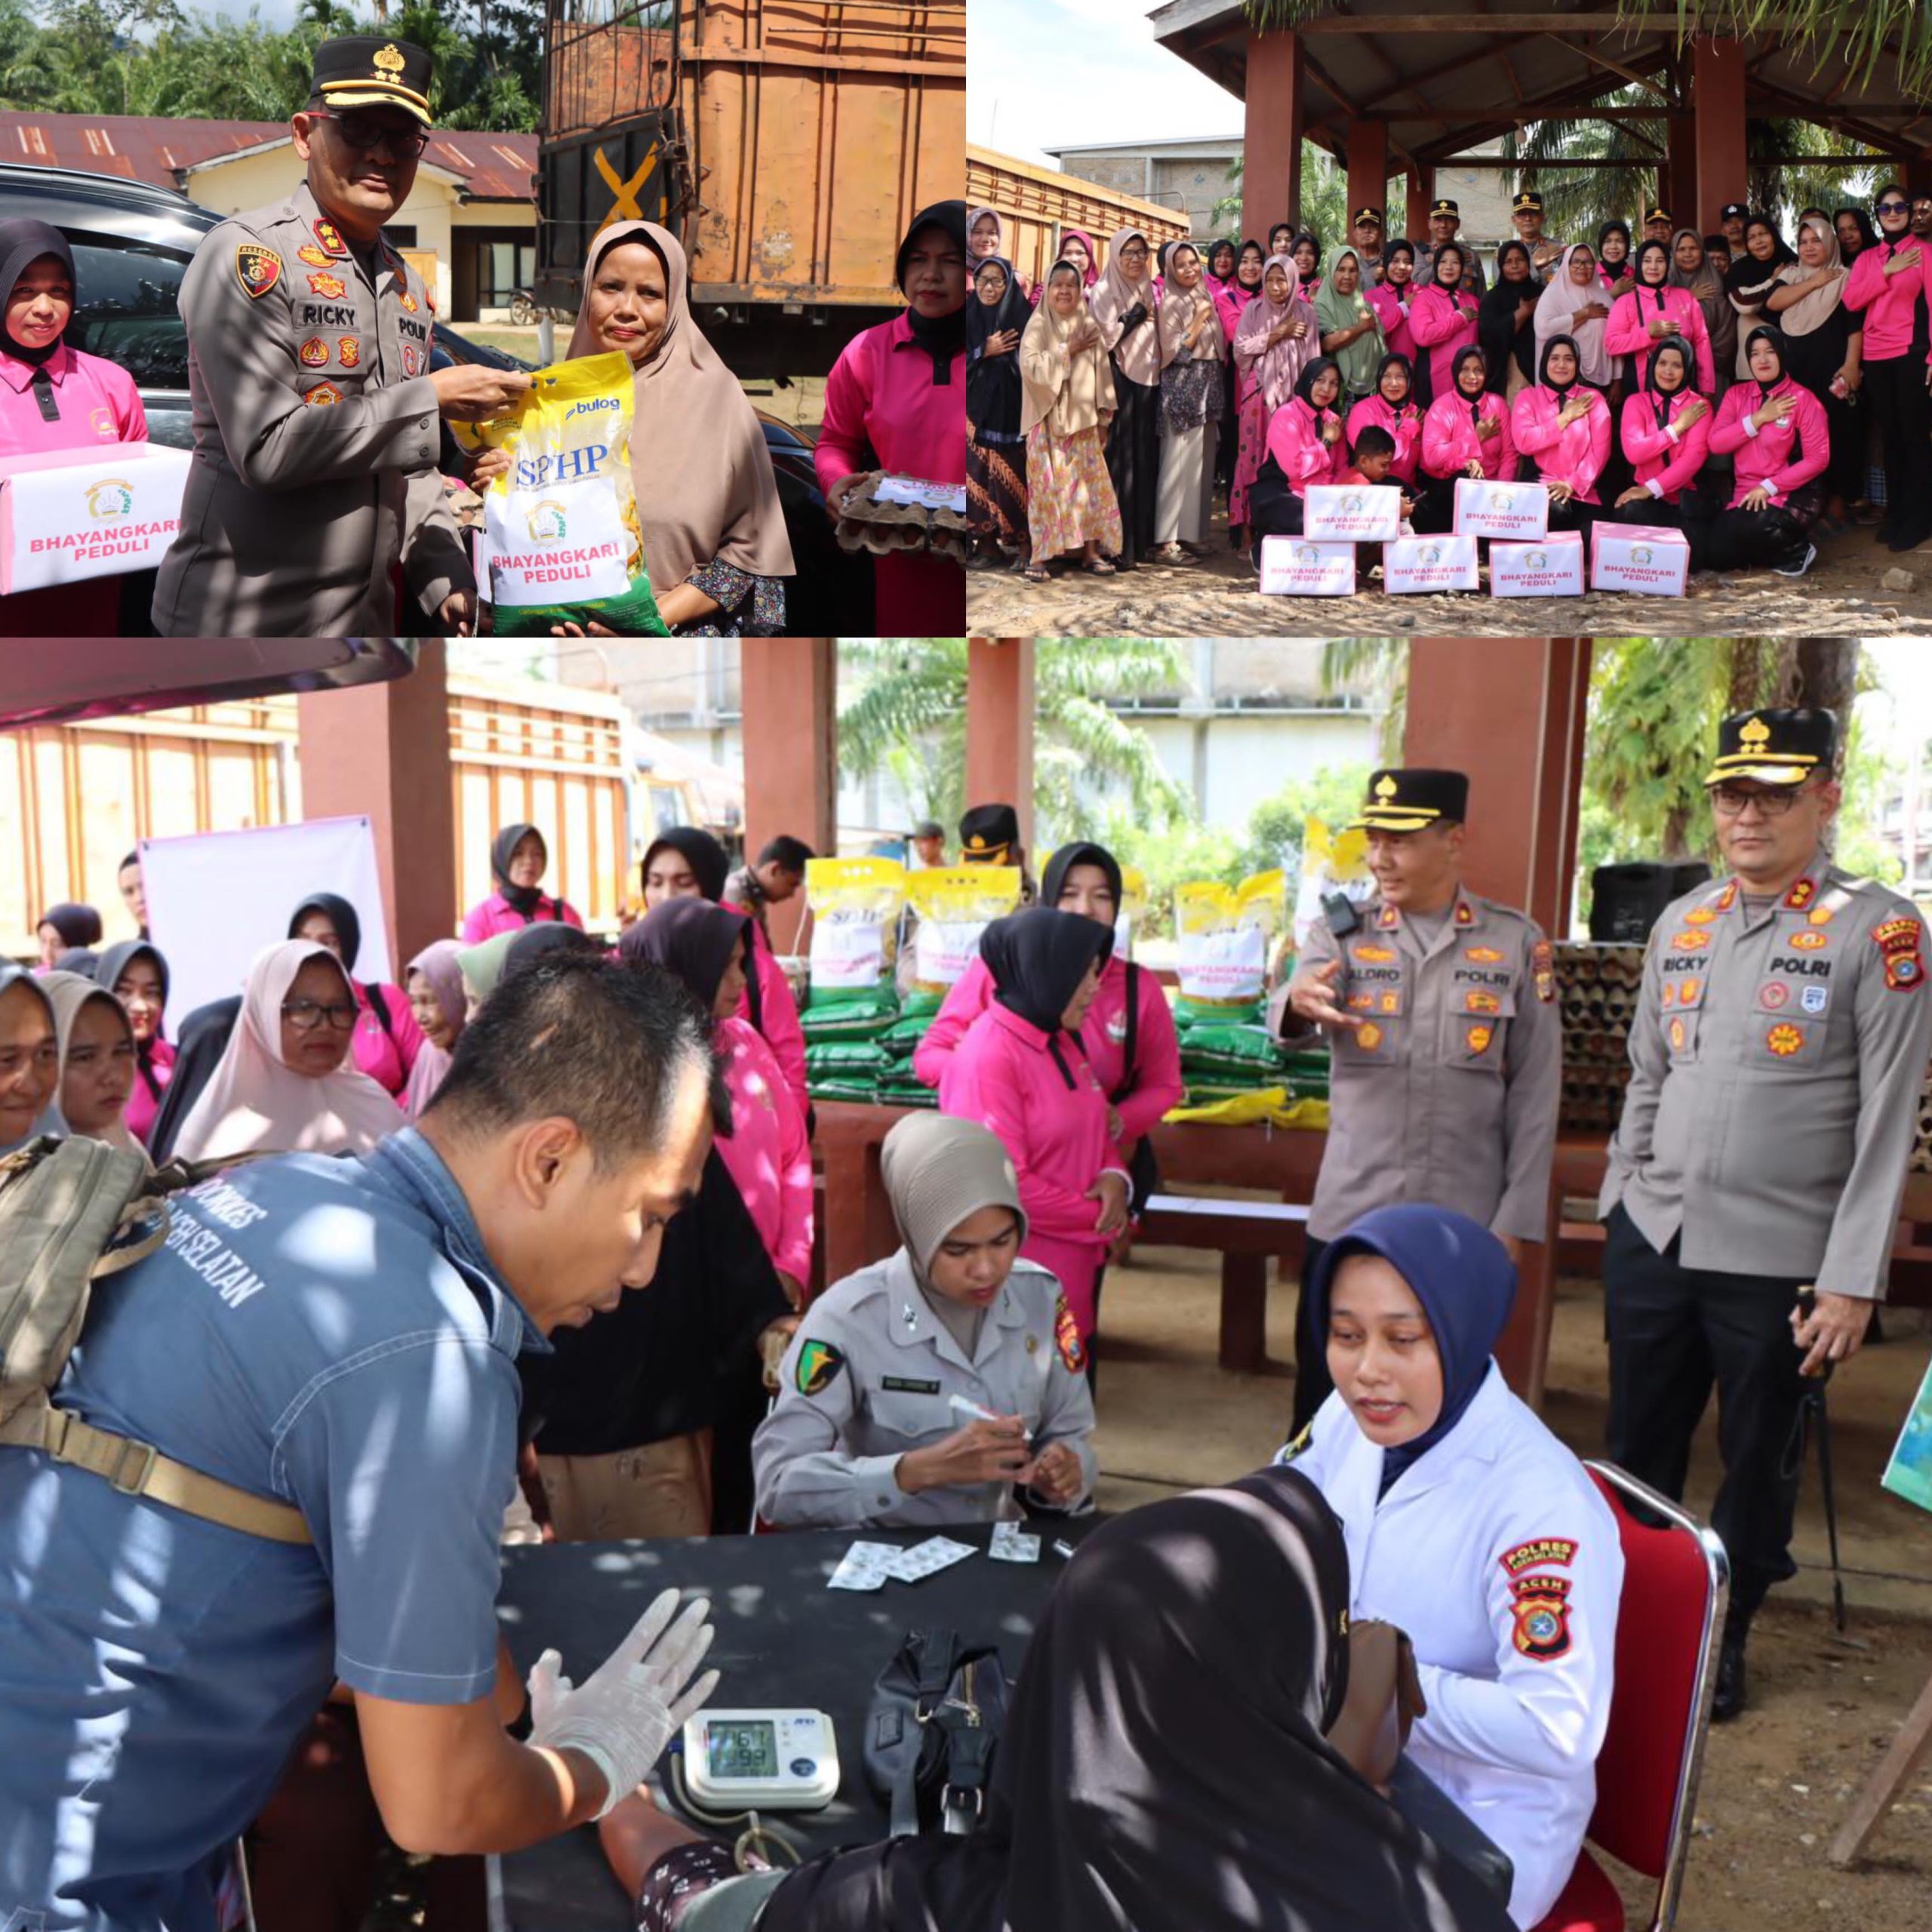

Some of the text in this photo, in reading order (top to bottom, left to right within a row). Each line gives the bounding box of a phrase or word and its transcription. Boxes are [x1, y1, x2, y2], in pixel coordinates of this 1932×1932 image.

[303, 305, 355, 326] RICKY
[577, 398, 620, 414] bulog
[516, 444, 608, 486] SPHP
[1466, 513, 1537, 523] BHAYANGKARI
[1484, 521, 1521, 529] PEDULI
[30, 519, 182, 552] BHAYANGKARI
[75, 538, 149, 561] PEDULI
[492, 543, 620, 569] BHAYANGKARI
[525, 565, 591, 583] PEDULI
[1393, 566, 1466, 576] BHAYANGKARI
[1500, 572, 1573, 580] BHAYANGKARI
[1604, 565, 1676, 577] BHAYANGKARI
[1622, 574, 1659, 583] PEDULI
[1663, 956, 1708, 972] RICKY
[1770, 958, 1832, 977] POLRI
[1454, 969, 1510, 986] POLRI
[177, 1229, 266, 1309] SELATAN
[1518, 1577, 1563, 1591] ACEH
